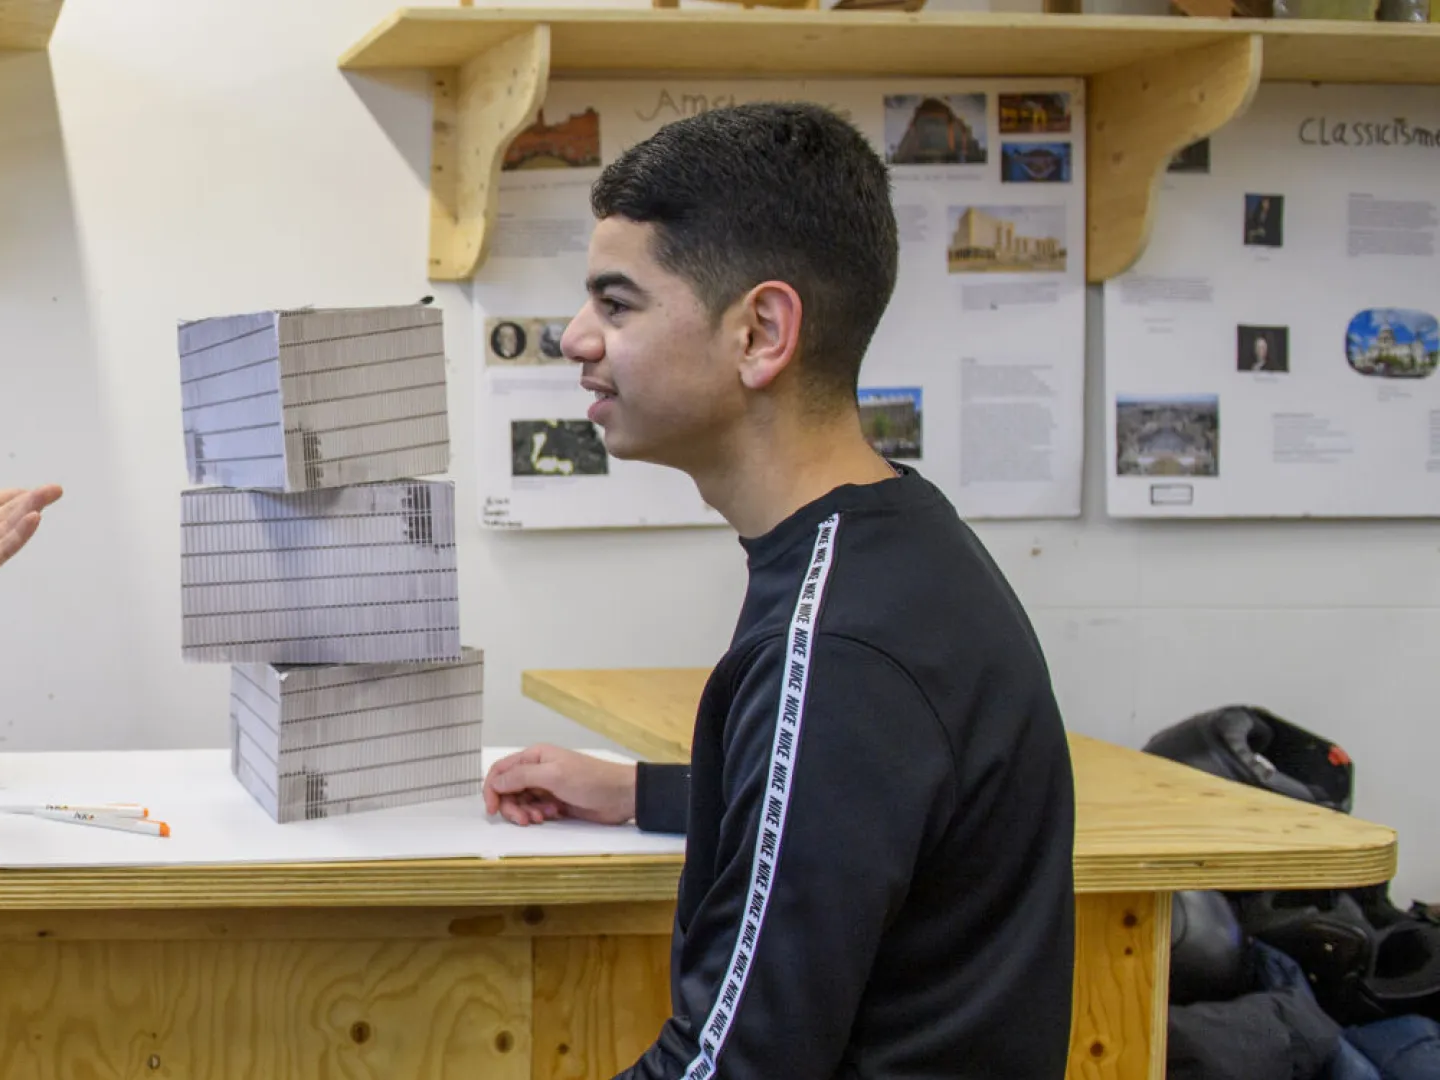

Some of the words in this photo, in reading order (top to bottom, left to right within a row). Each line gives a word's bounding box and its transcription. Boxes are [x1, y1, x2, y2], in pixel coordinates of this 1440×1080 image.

[796, 603, 813, 624] NIKE
[793, 627, 809, 659] NIKE
[789, 660, 805, 693] NIKE
[783, 693, 800, 727] NIKE
[776, 727, 794, 761] NIKE
[771, 761, 788, 794] NIKE
[767, 794, 783, 828] NIKE
[761, 827, 777, 860] NIKE
[755, 858, 771, 891] NIKE
[748, 888, 765, 923] NIKE
[741, 920, 757, 953] NIKE
[732, 949, 749, 983] NIKE
[721, 978, 739, 1012] NIKE
[708, 1009, 729, 1041] NIKE
